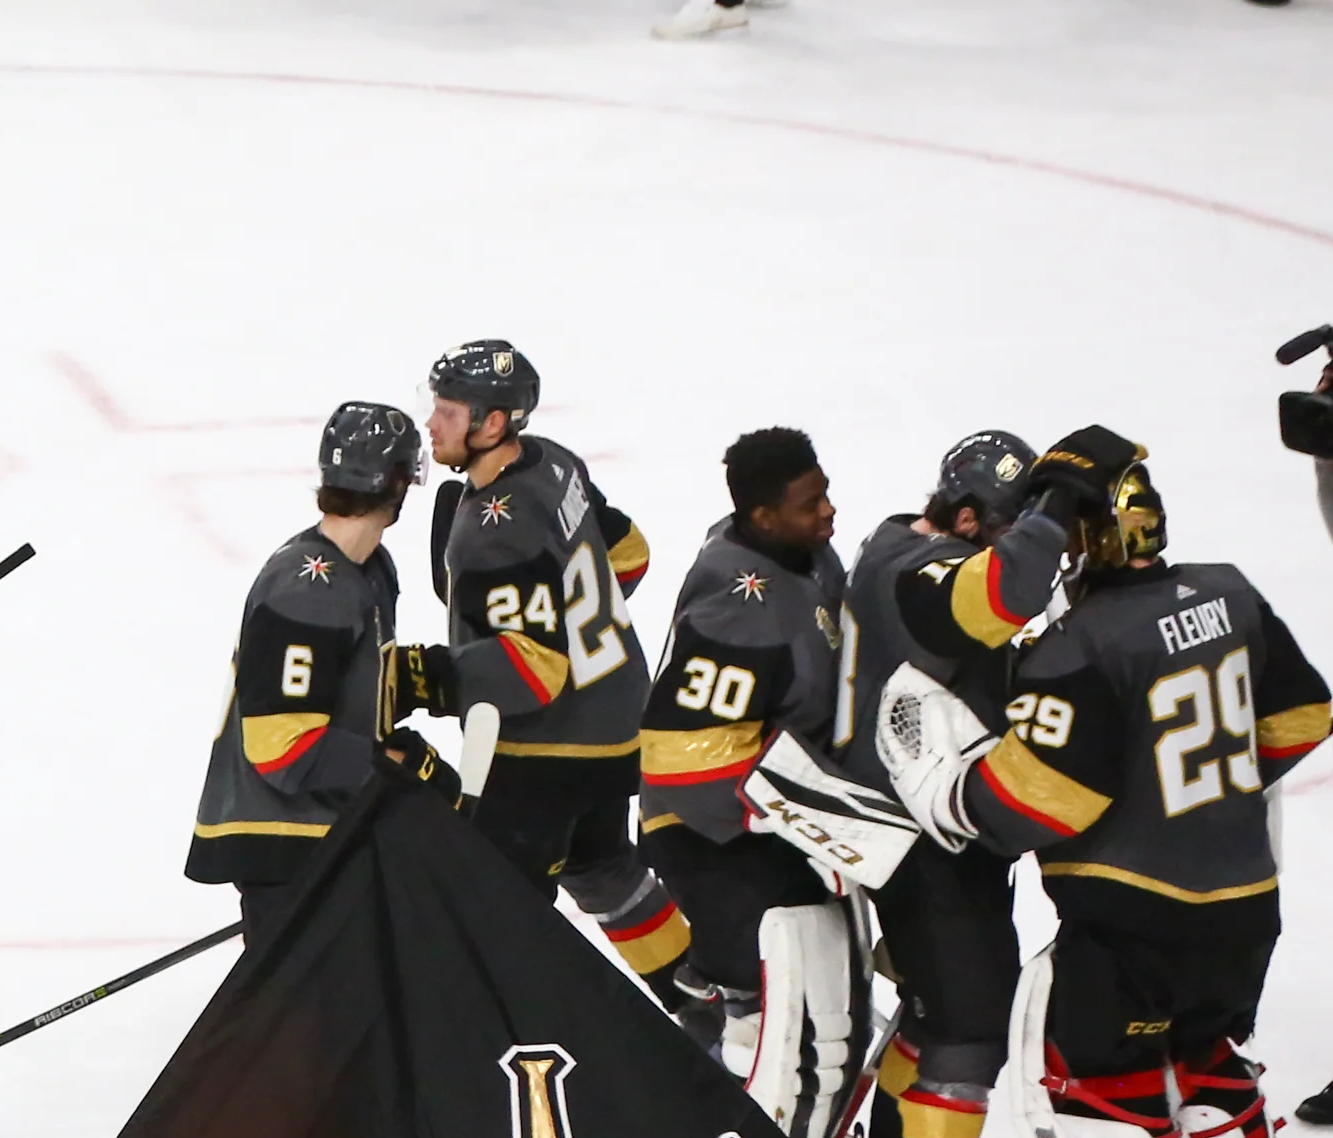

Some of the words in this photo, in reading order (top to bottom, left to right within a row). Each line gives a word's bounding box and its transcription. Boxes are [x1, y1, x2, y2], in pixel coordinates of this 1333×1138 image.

[333, 448, 342, 465] 6
[486, 583, 557, 632] 24
[1158, 597, 1232, 654] FLEURY
[282, 644, 313, 697] 6
[676, 656, 756, 720] 30
[1006, 693, 1074, 748] 29
[1148, 646, 1262, 817] 29
[764, 799, 864, 866] CCM
[34, 992, 96, 1027] RIBCOR
